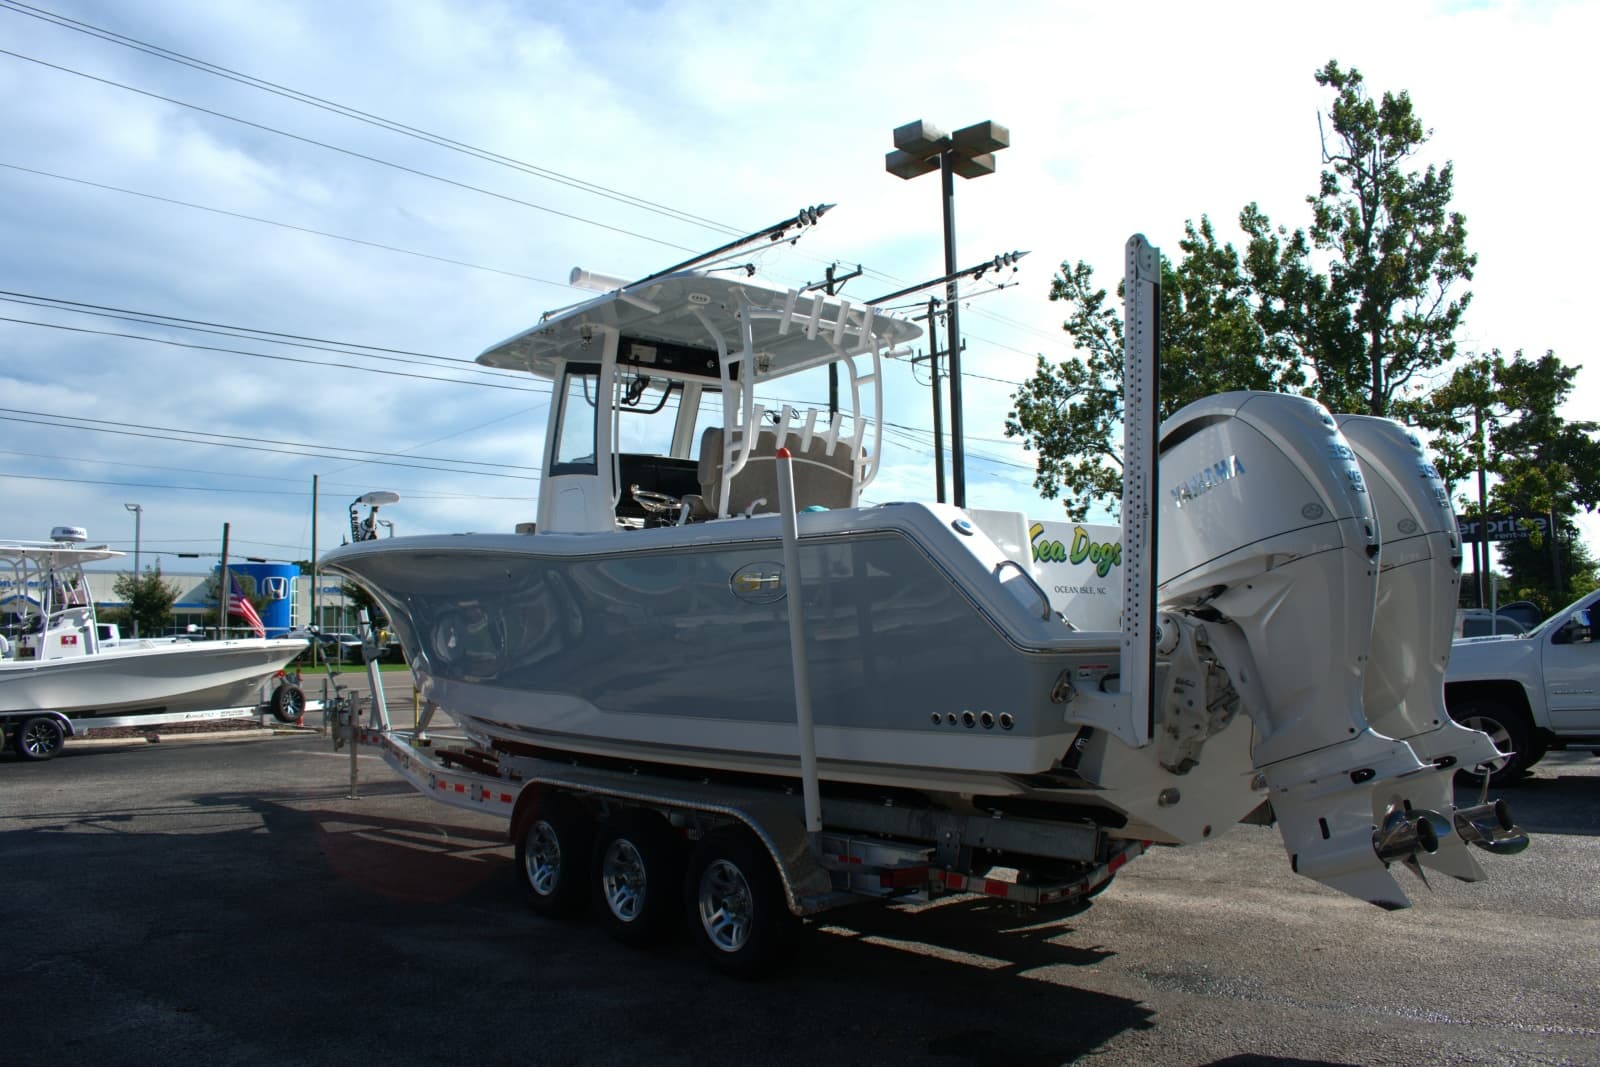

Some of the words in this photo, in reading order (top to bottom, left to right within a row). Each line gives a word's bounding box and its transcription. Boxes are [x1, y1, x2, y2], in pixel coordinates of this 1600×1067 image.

[1029, 522, 1067, 563] Sea
[1069, 525, 1122, 578] Dogs
[1054, 585, 1079, 595] OCEAN
[1096, 585, 1107, 595] NC
